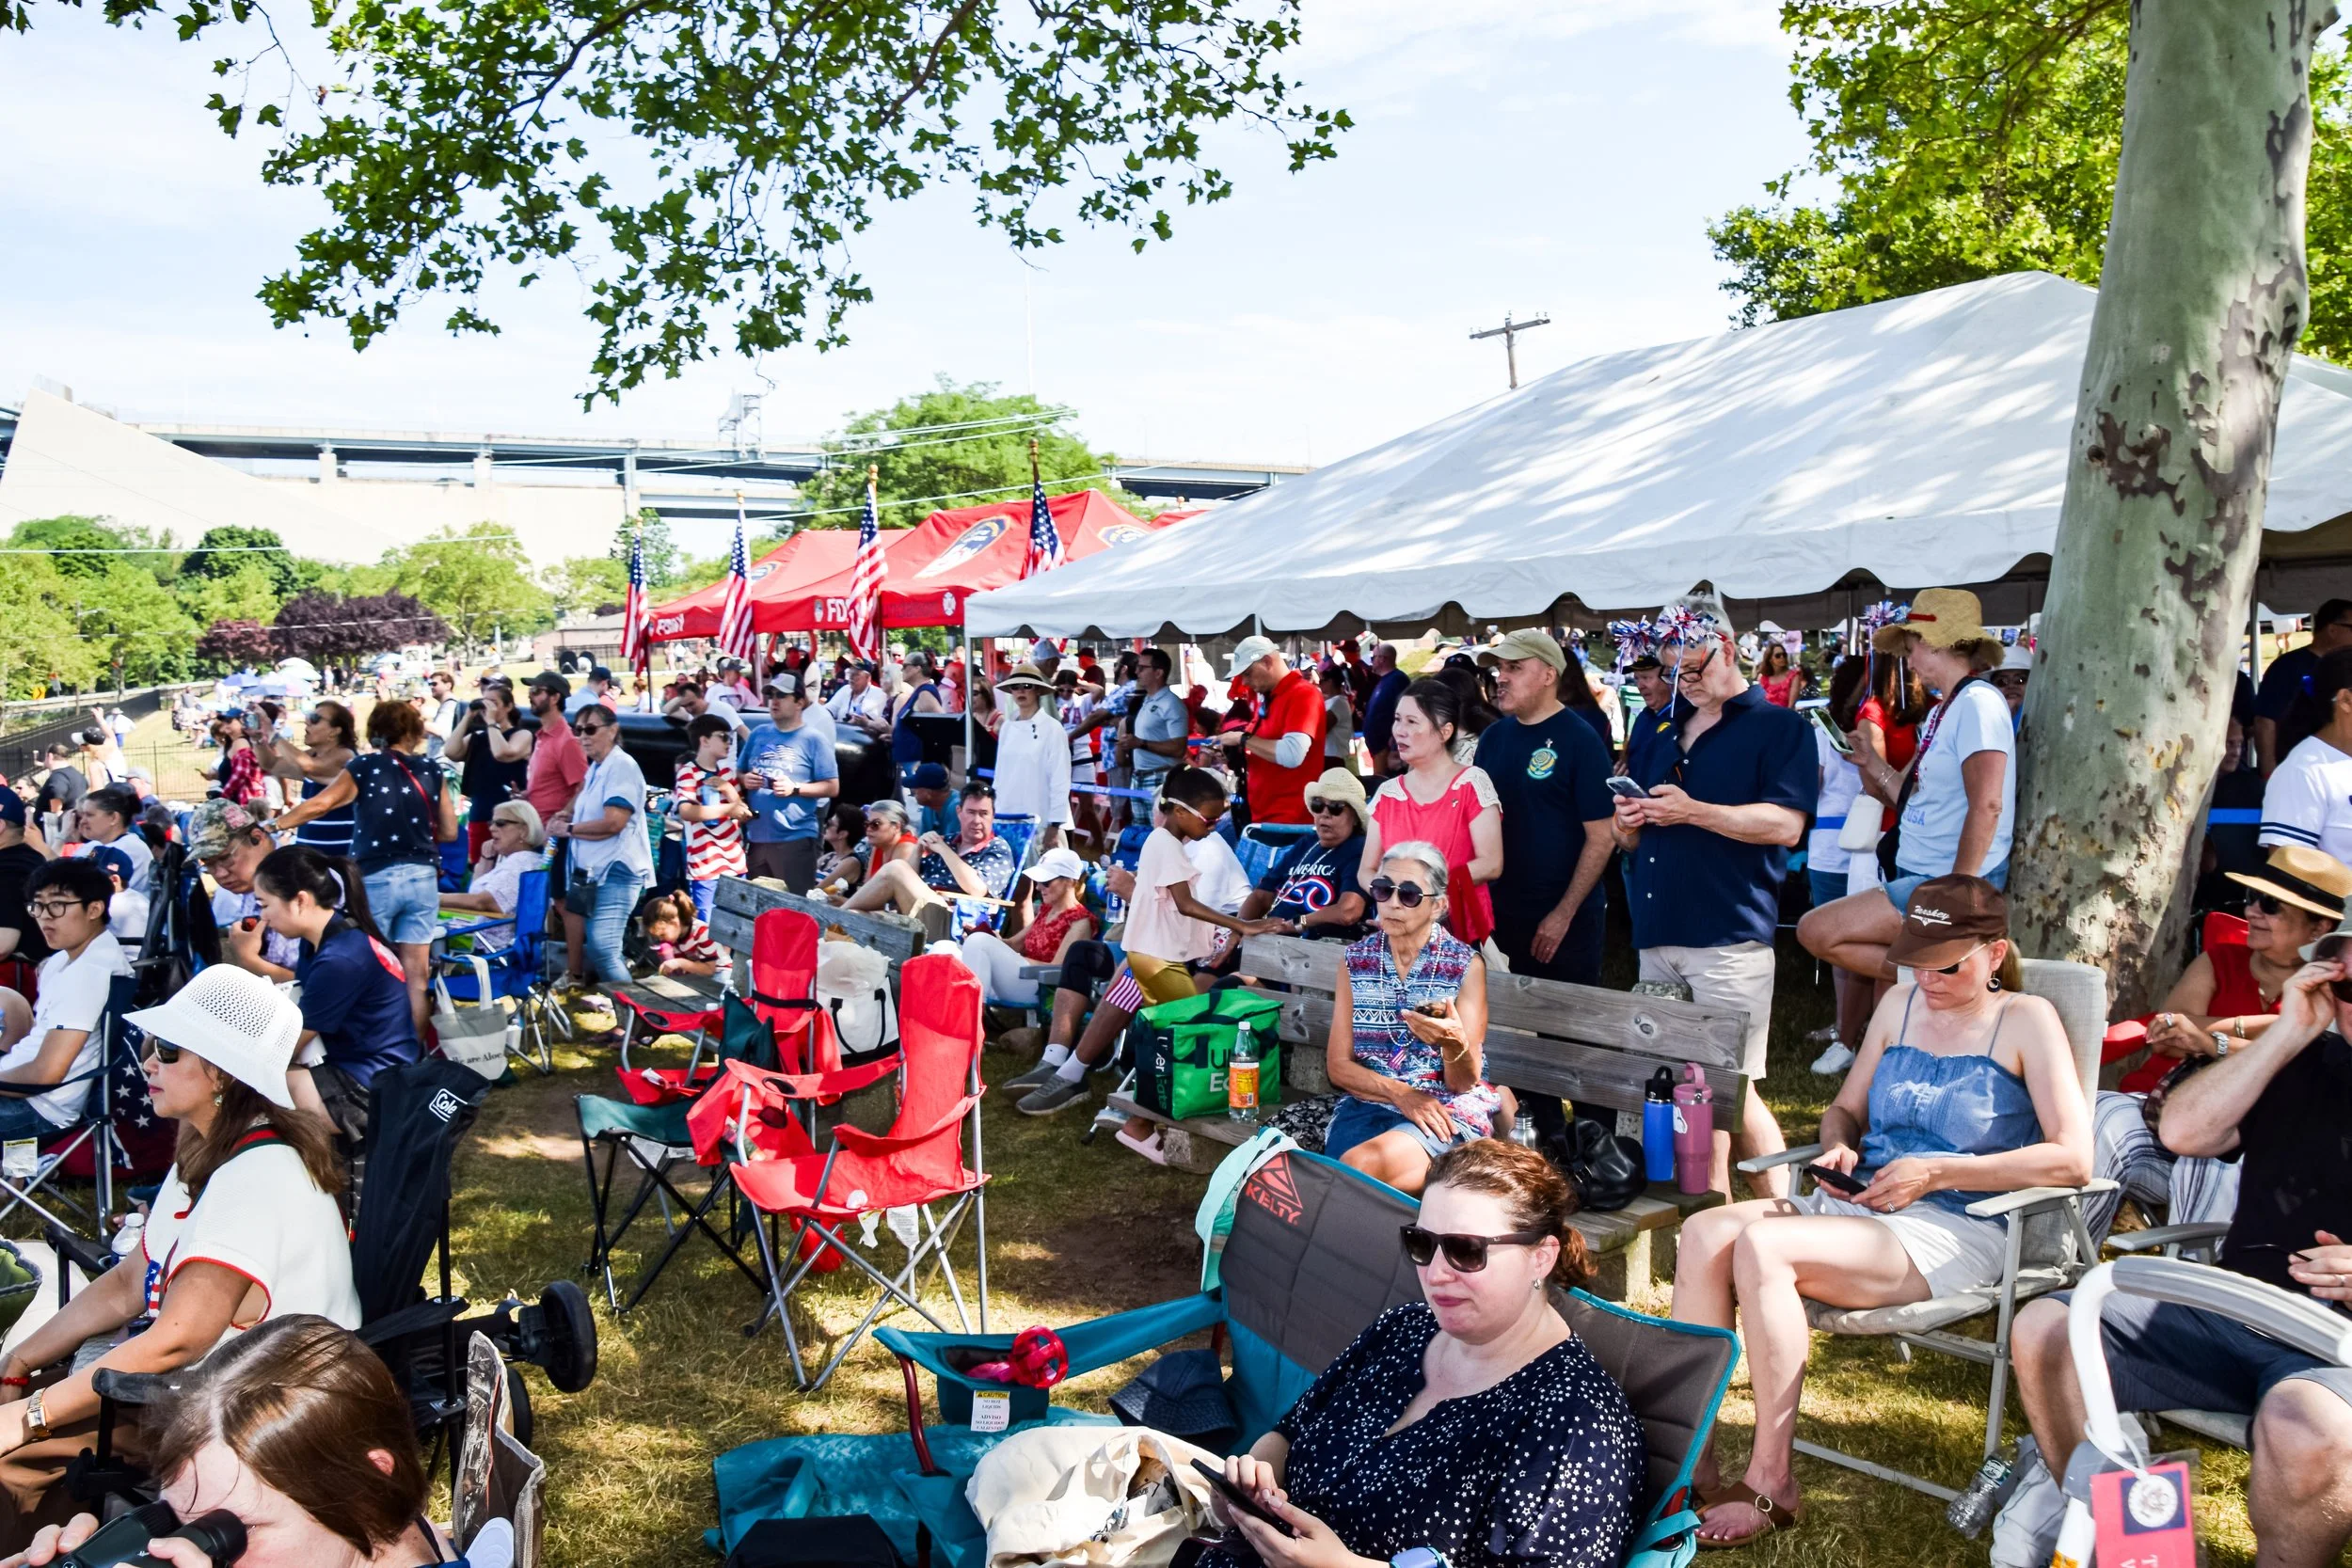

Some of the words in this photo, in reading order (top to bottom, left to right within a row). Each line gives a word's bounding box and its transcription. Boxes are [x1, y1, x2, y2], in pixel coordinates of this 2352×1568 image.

[1914, 905, 1950, 921] Hershey
[467, 1055, 482, 1065] are
[436, 1093, 458, 1114] Cole
[1245, 1182, 1302, 1225] KELTY
